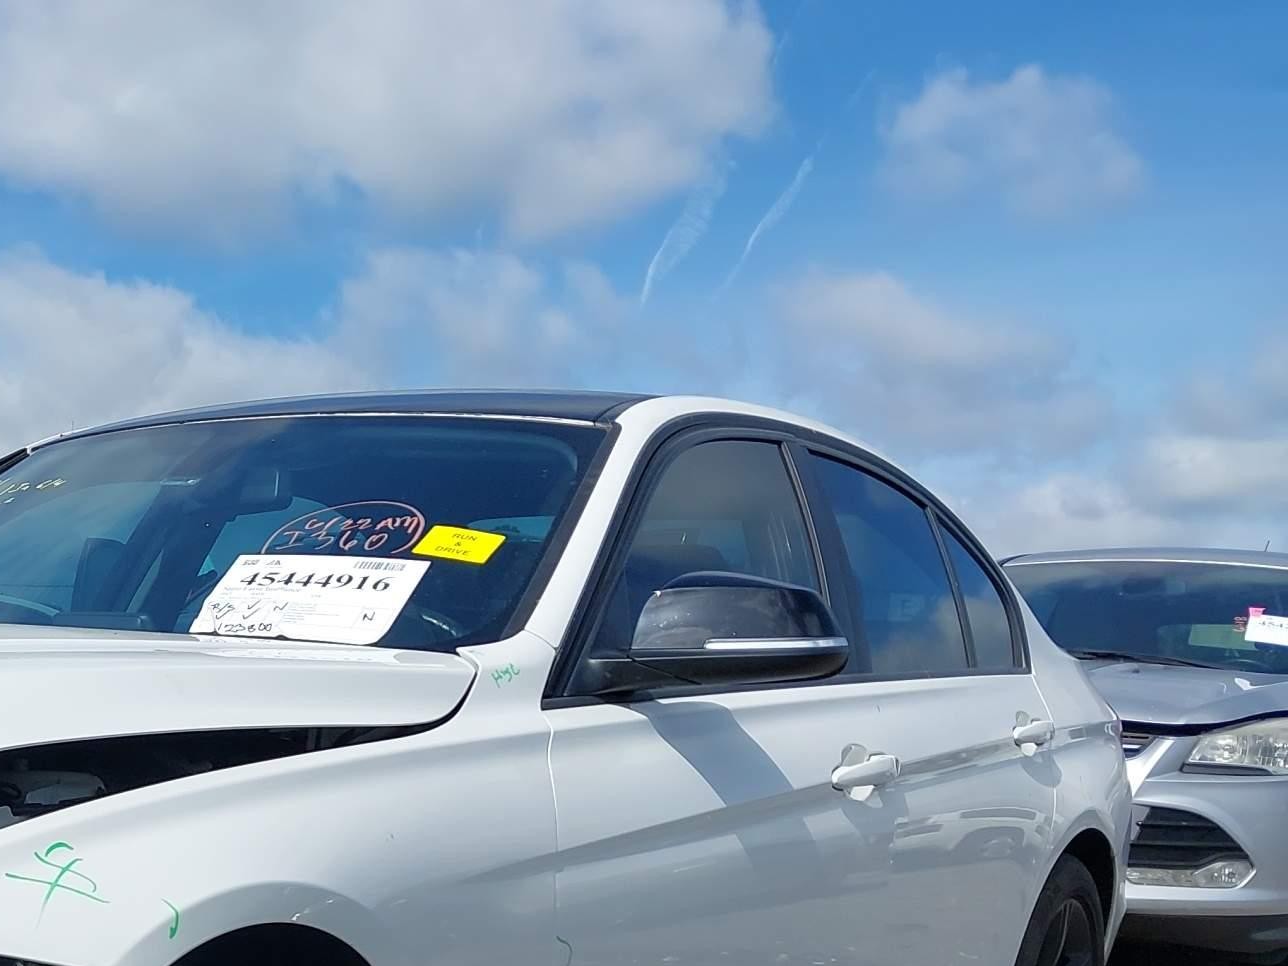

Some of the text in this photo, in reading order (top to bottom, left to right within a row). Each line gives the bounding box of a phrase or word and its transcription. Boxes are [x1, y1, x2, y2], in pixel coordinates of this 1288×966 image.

[374, 515, 419, 534] AM
[451, 533, 479, 542] RUN
[434, 545, 472, 556] DRIVE
[239, 571, 398, 592] 45444916
